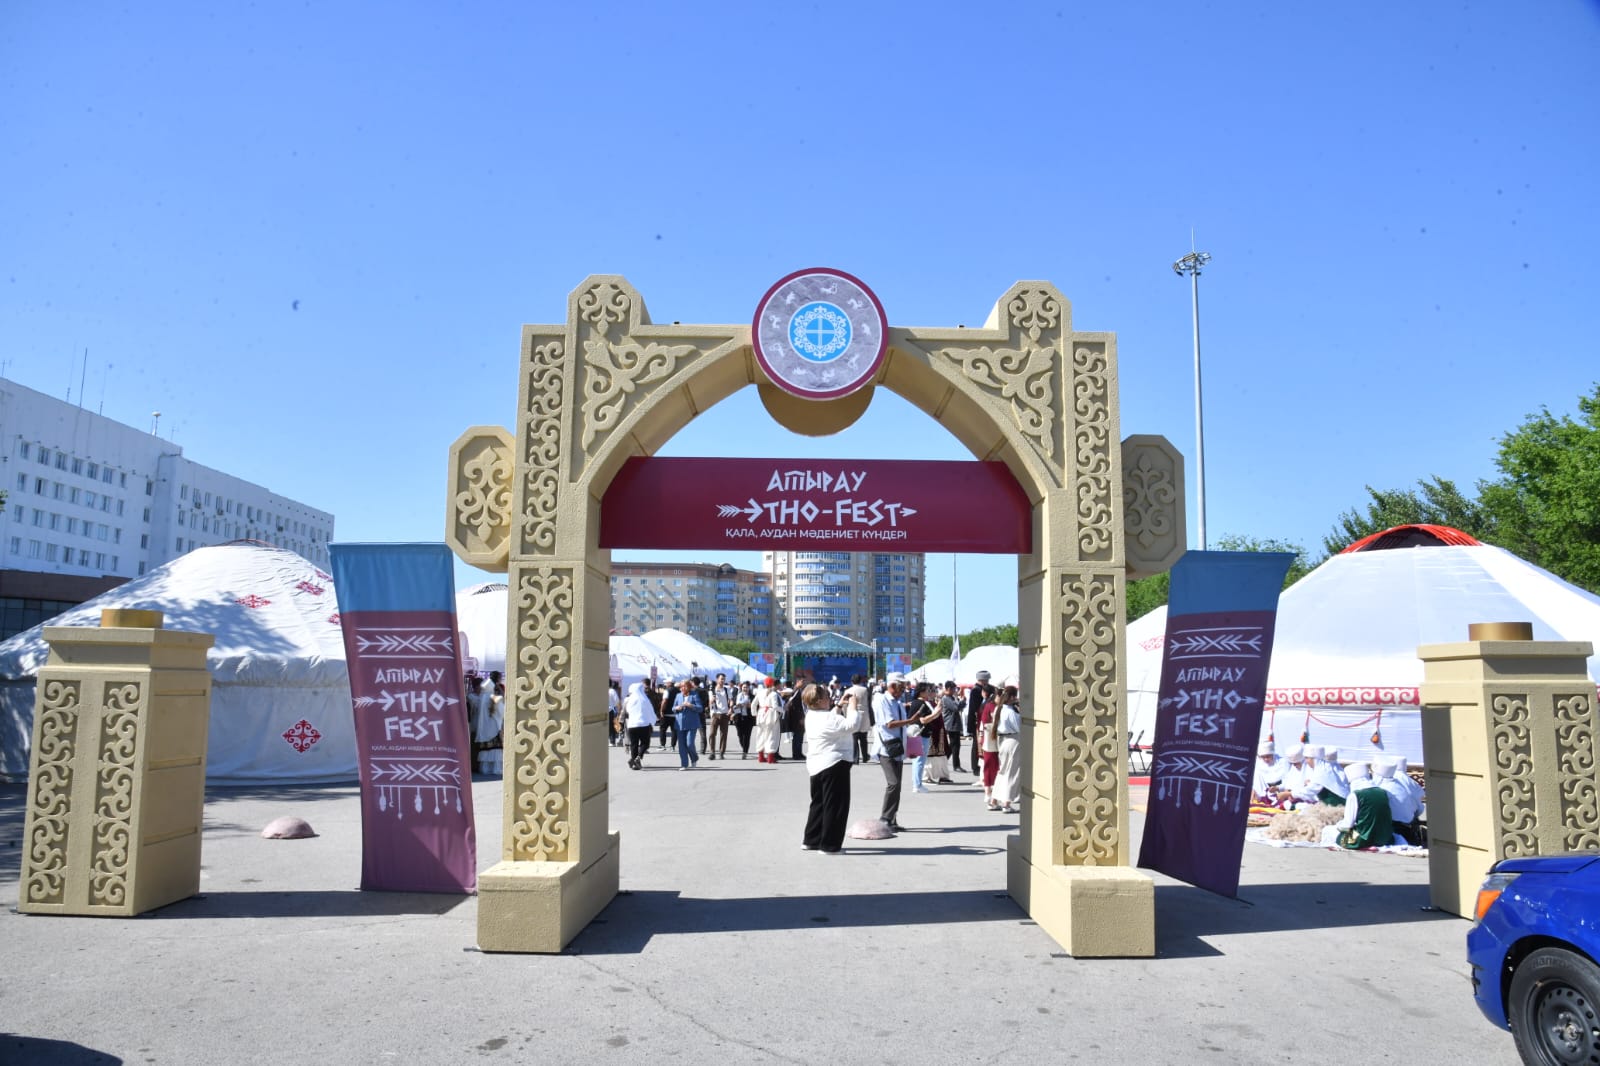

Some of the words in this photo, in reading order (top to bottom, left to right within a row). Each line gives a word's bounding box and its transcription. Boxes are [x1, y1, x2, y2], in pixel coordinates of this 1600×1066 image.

[766, 469, 867, 493] АТЫРАУ
[725, 528, 758, 539] ҚАЛА,
[760, 528, 797, 539] АУДАН
[799, 529, 860, 540] МӘДЕНИЕТ
[862, 530, 907, 541] КҮНДЕРІ
[374, 667, 445, 684] АТЫРАУ
[1175, 666, 1246, 683] АТЫРАУ
[384, 716, 443, 741] FEST
[1174, 713, 1237, 739] FEST
